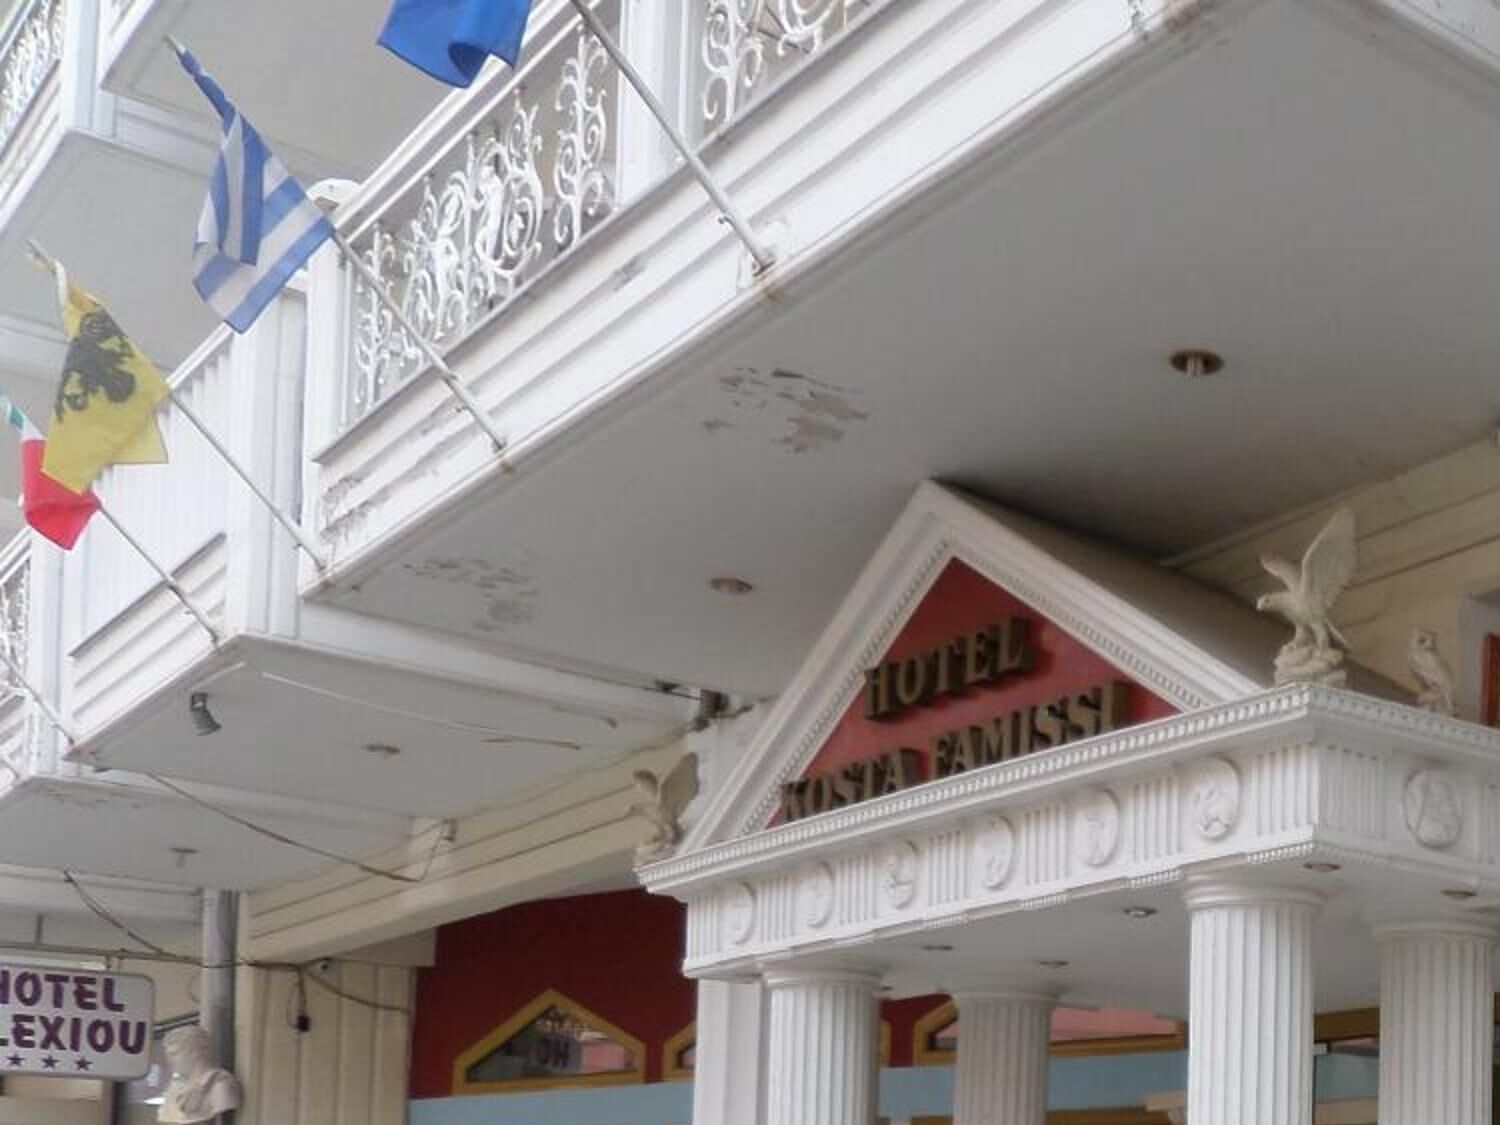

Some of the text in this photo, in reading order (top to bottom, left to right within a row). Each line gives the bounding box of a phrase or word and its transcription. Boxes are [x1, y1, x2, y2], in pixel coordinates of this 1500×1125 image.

[864, 617, 1029, 720] HOTEL
[782, 682, 1117, 820] KOSTA FAMISSI
